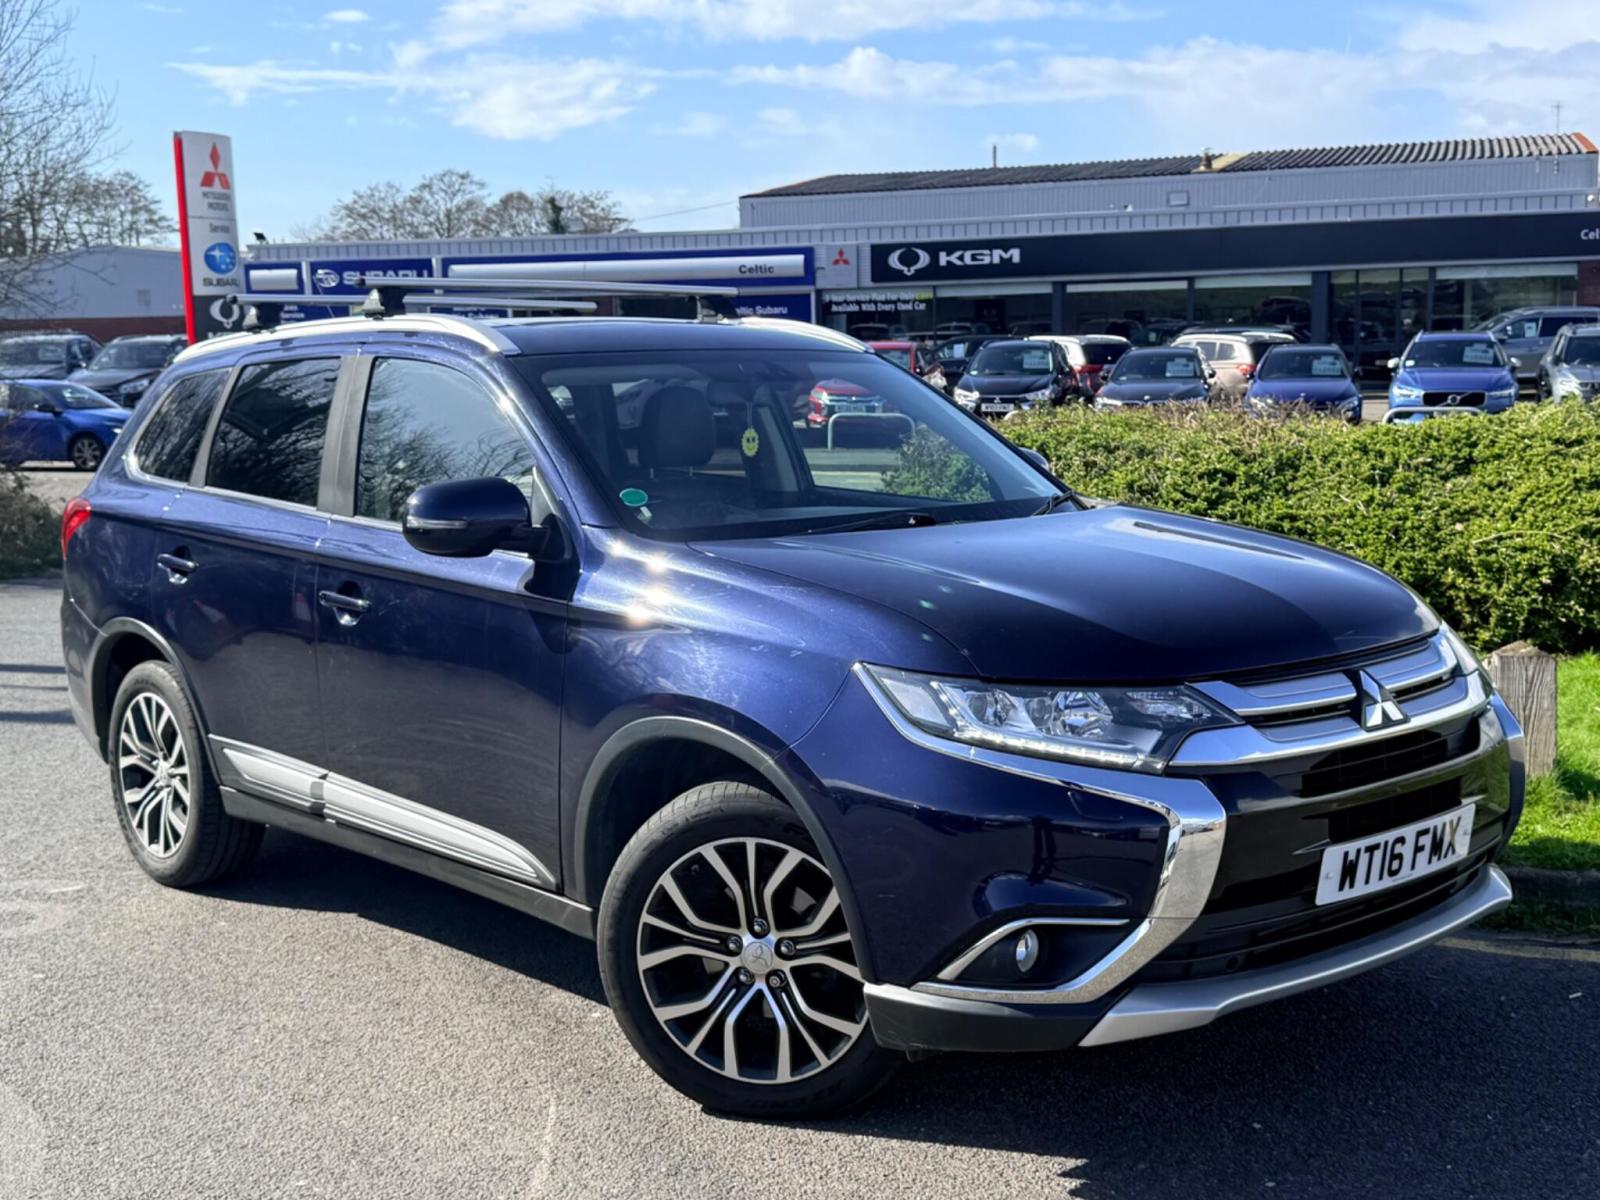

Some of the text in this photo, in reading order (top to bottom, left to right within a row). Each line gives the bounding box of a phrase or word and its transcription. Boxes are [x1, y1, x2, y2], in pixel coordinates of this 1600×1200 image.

[1580, 228, 1600, 240] Cel
[939, 248, 1020, 266] KGM
[738, 264, 775, 274] Celtic
[755, 305, 788, 314] Subaru
[1338, 816, 1462, 892] WT16 FMX
